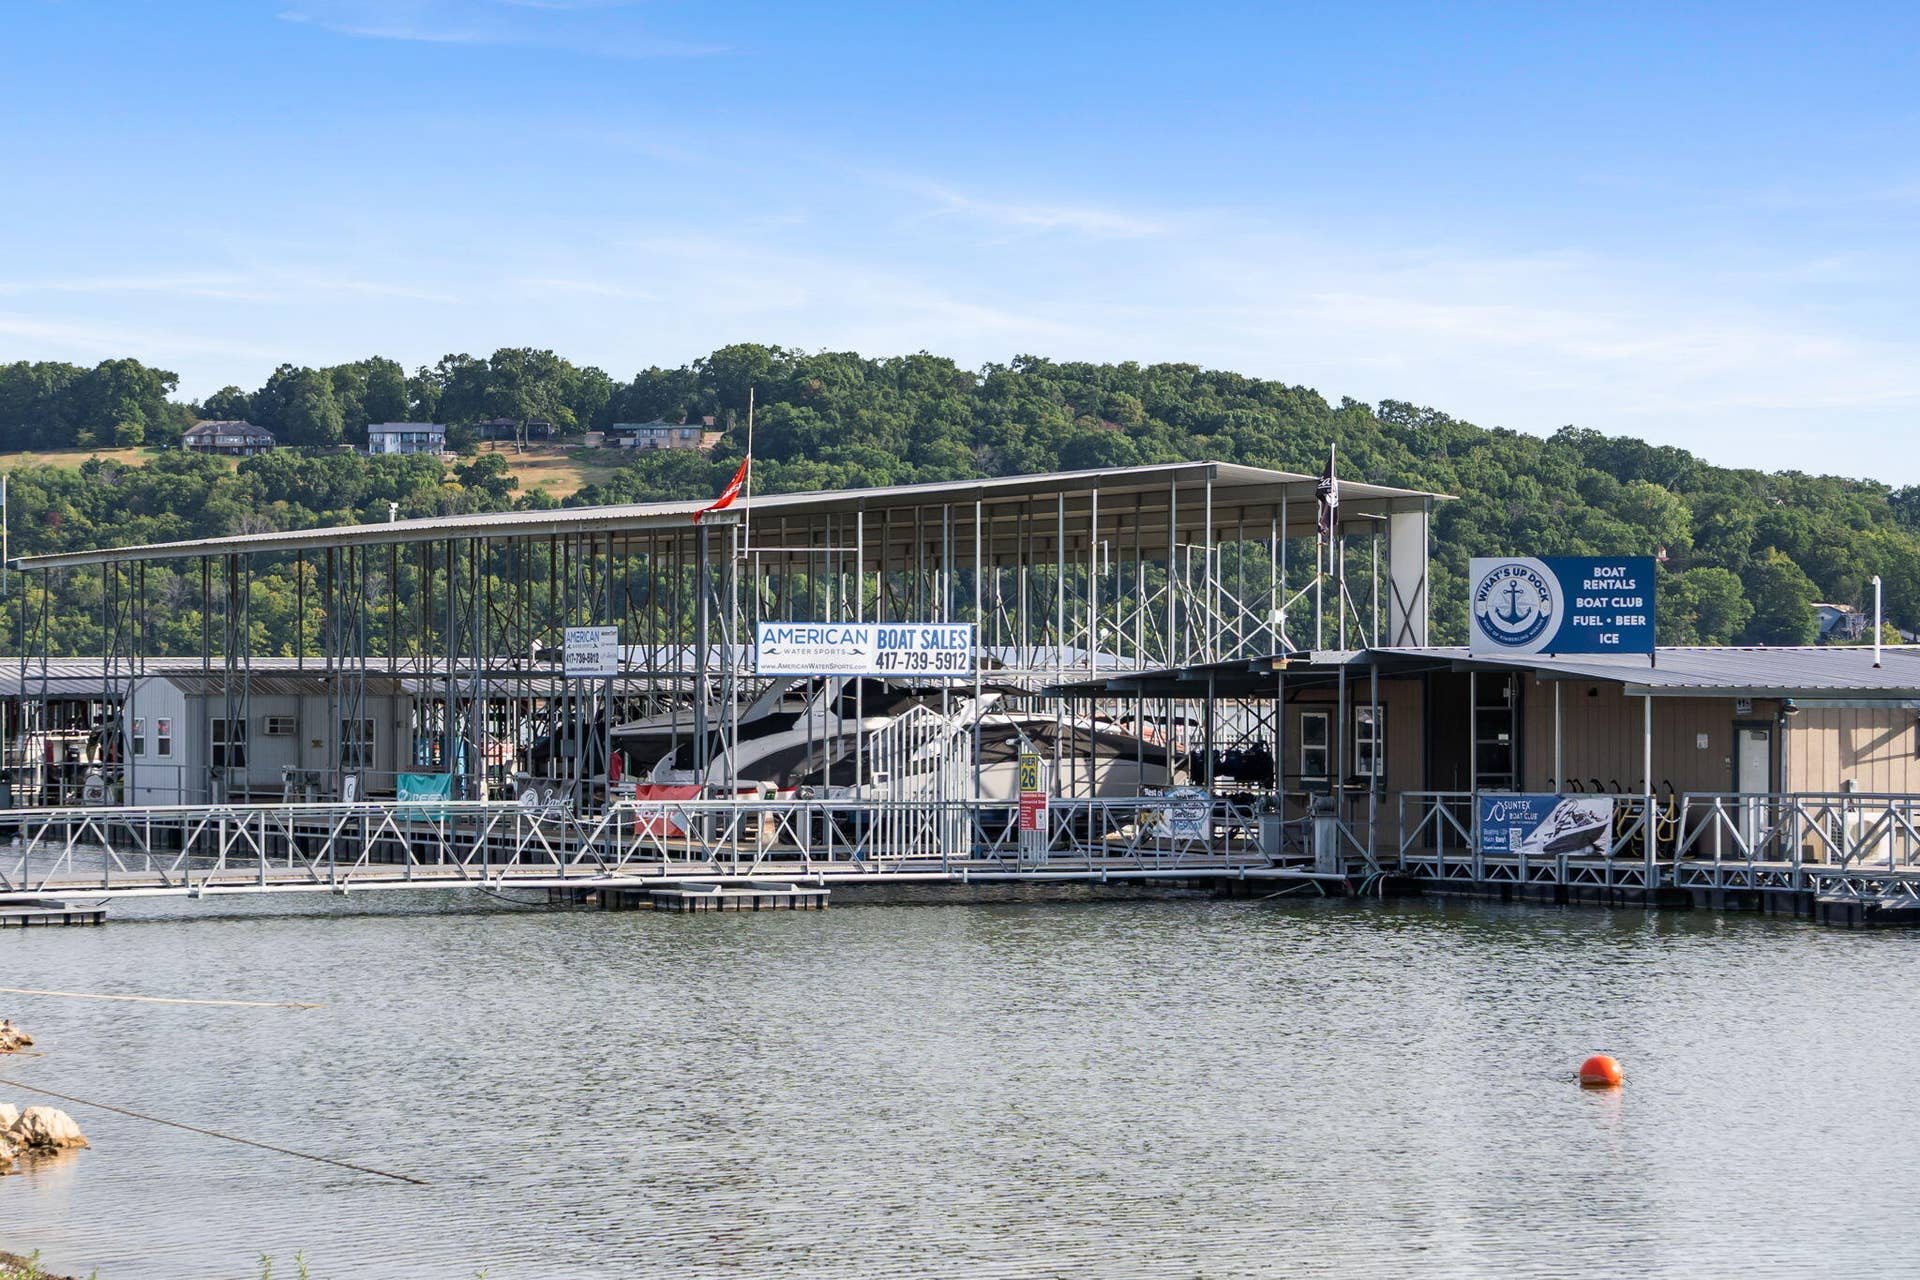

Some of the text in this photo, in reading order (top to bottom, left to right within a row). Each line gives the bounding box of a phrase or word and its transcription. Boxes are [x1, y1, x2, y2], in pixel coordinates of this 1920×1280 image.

[1593, 567, 1626, 577] BOAT
[1478, 567, 1550, 603] WHAT'S UP DOCK
[1583, 579, 1637, 590] RENTALS
[1575, 597, 1644, 608] BOAT CLUB
[1573, 615, 1646, 626] FUEL BEER
[566, 631, 600, 643] AMERICAN
[761, 628, 869, 645] AMERICAN
[876, 629, 968, 650] BOAT SALES
[1599, 633, 1620, 645] ICE
[875, 651, 967, 670] 417-739-5912
[1021, 757, 1036, 767] PIER
[1021, 768, 1036, 788] 26
[1503, 800, 1531, 813] SUNTEX
[1509, 812, 1538, 820] BOAT CLUB
